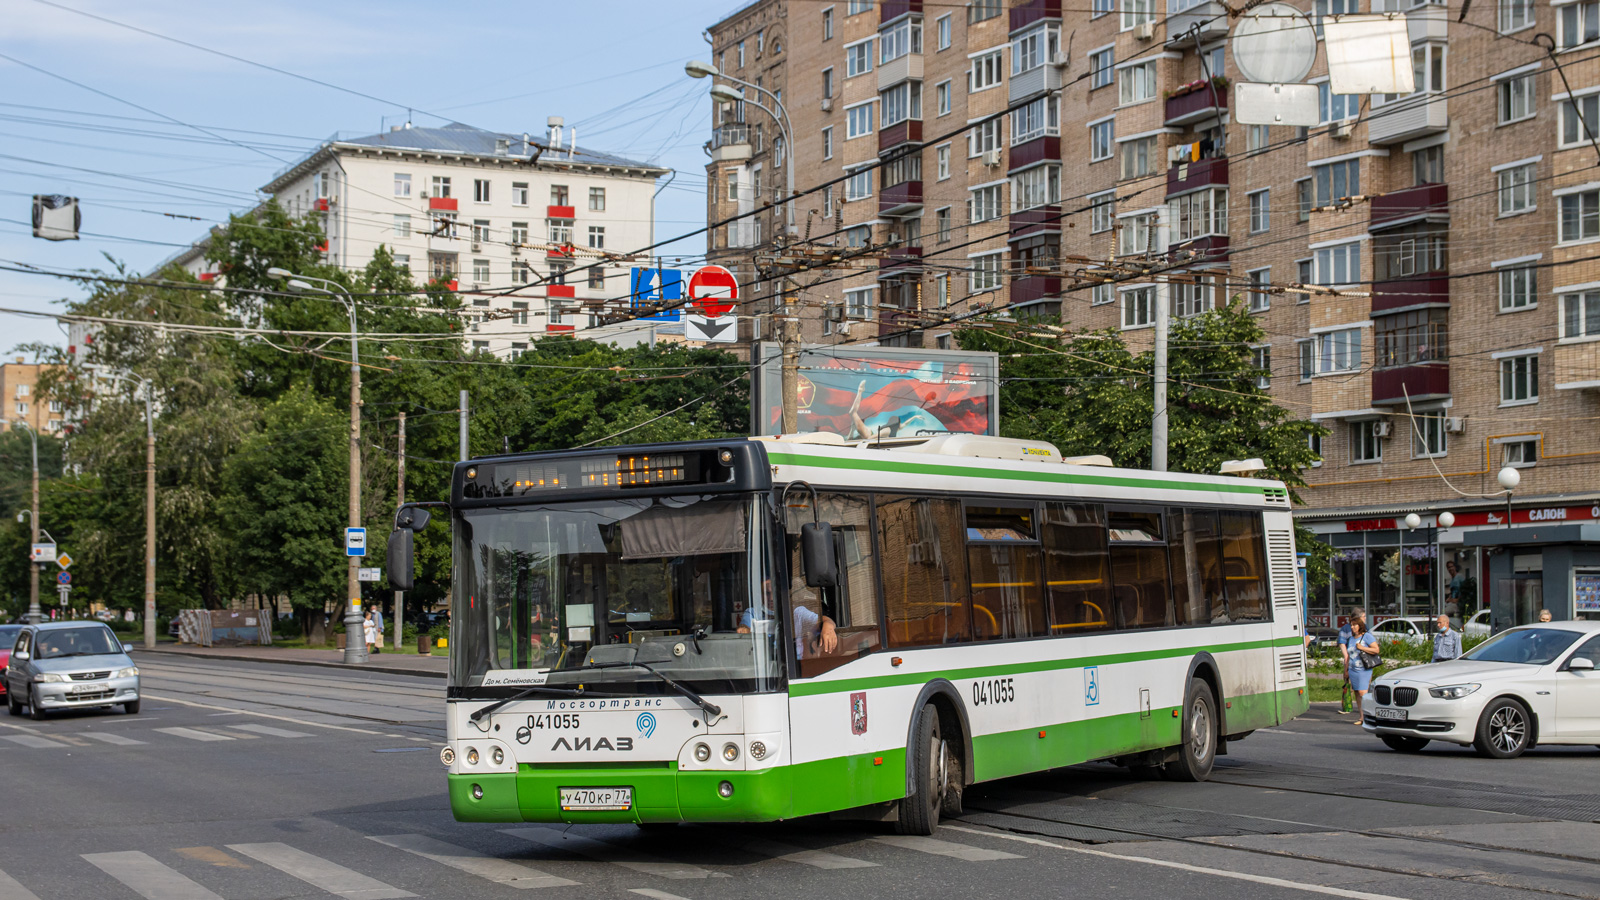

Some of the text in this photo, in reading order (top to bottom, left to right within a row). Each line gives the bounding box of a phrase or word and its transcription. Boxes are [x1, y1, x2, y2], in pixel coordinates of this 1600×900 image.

[1529, 508, 1566, 520] САЛОН
[973, 678, 1014, 706] 041055
[547, 698, 662, 709] Мосгортранс
[527, 714, 580, 729] 041055
[551, 737, 633, 751] ЛИАЗ
[615, 790, 626, 800] 77
